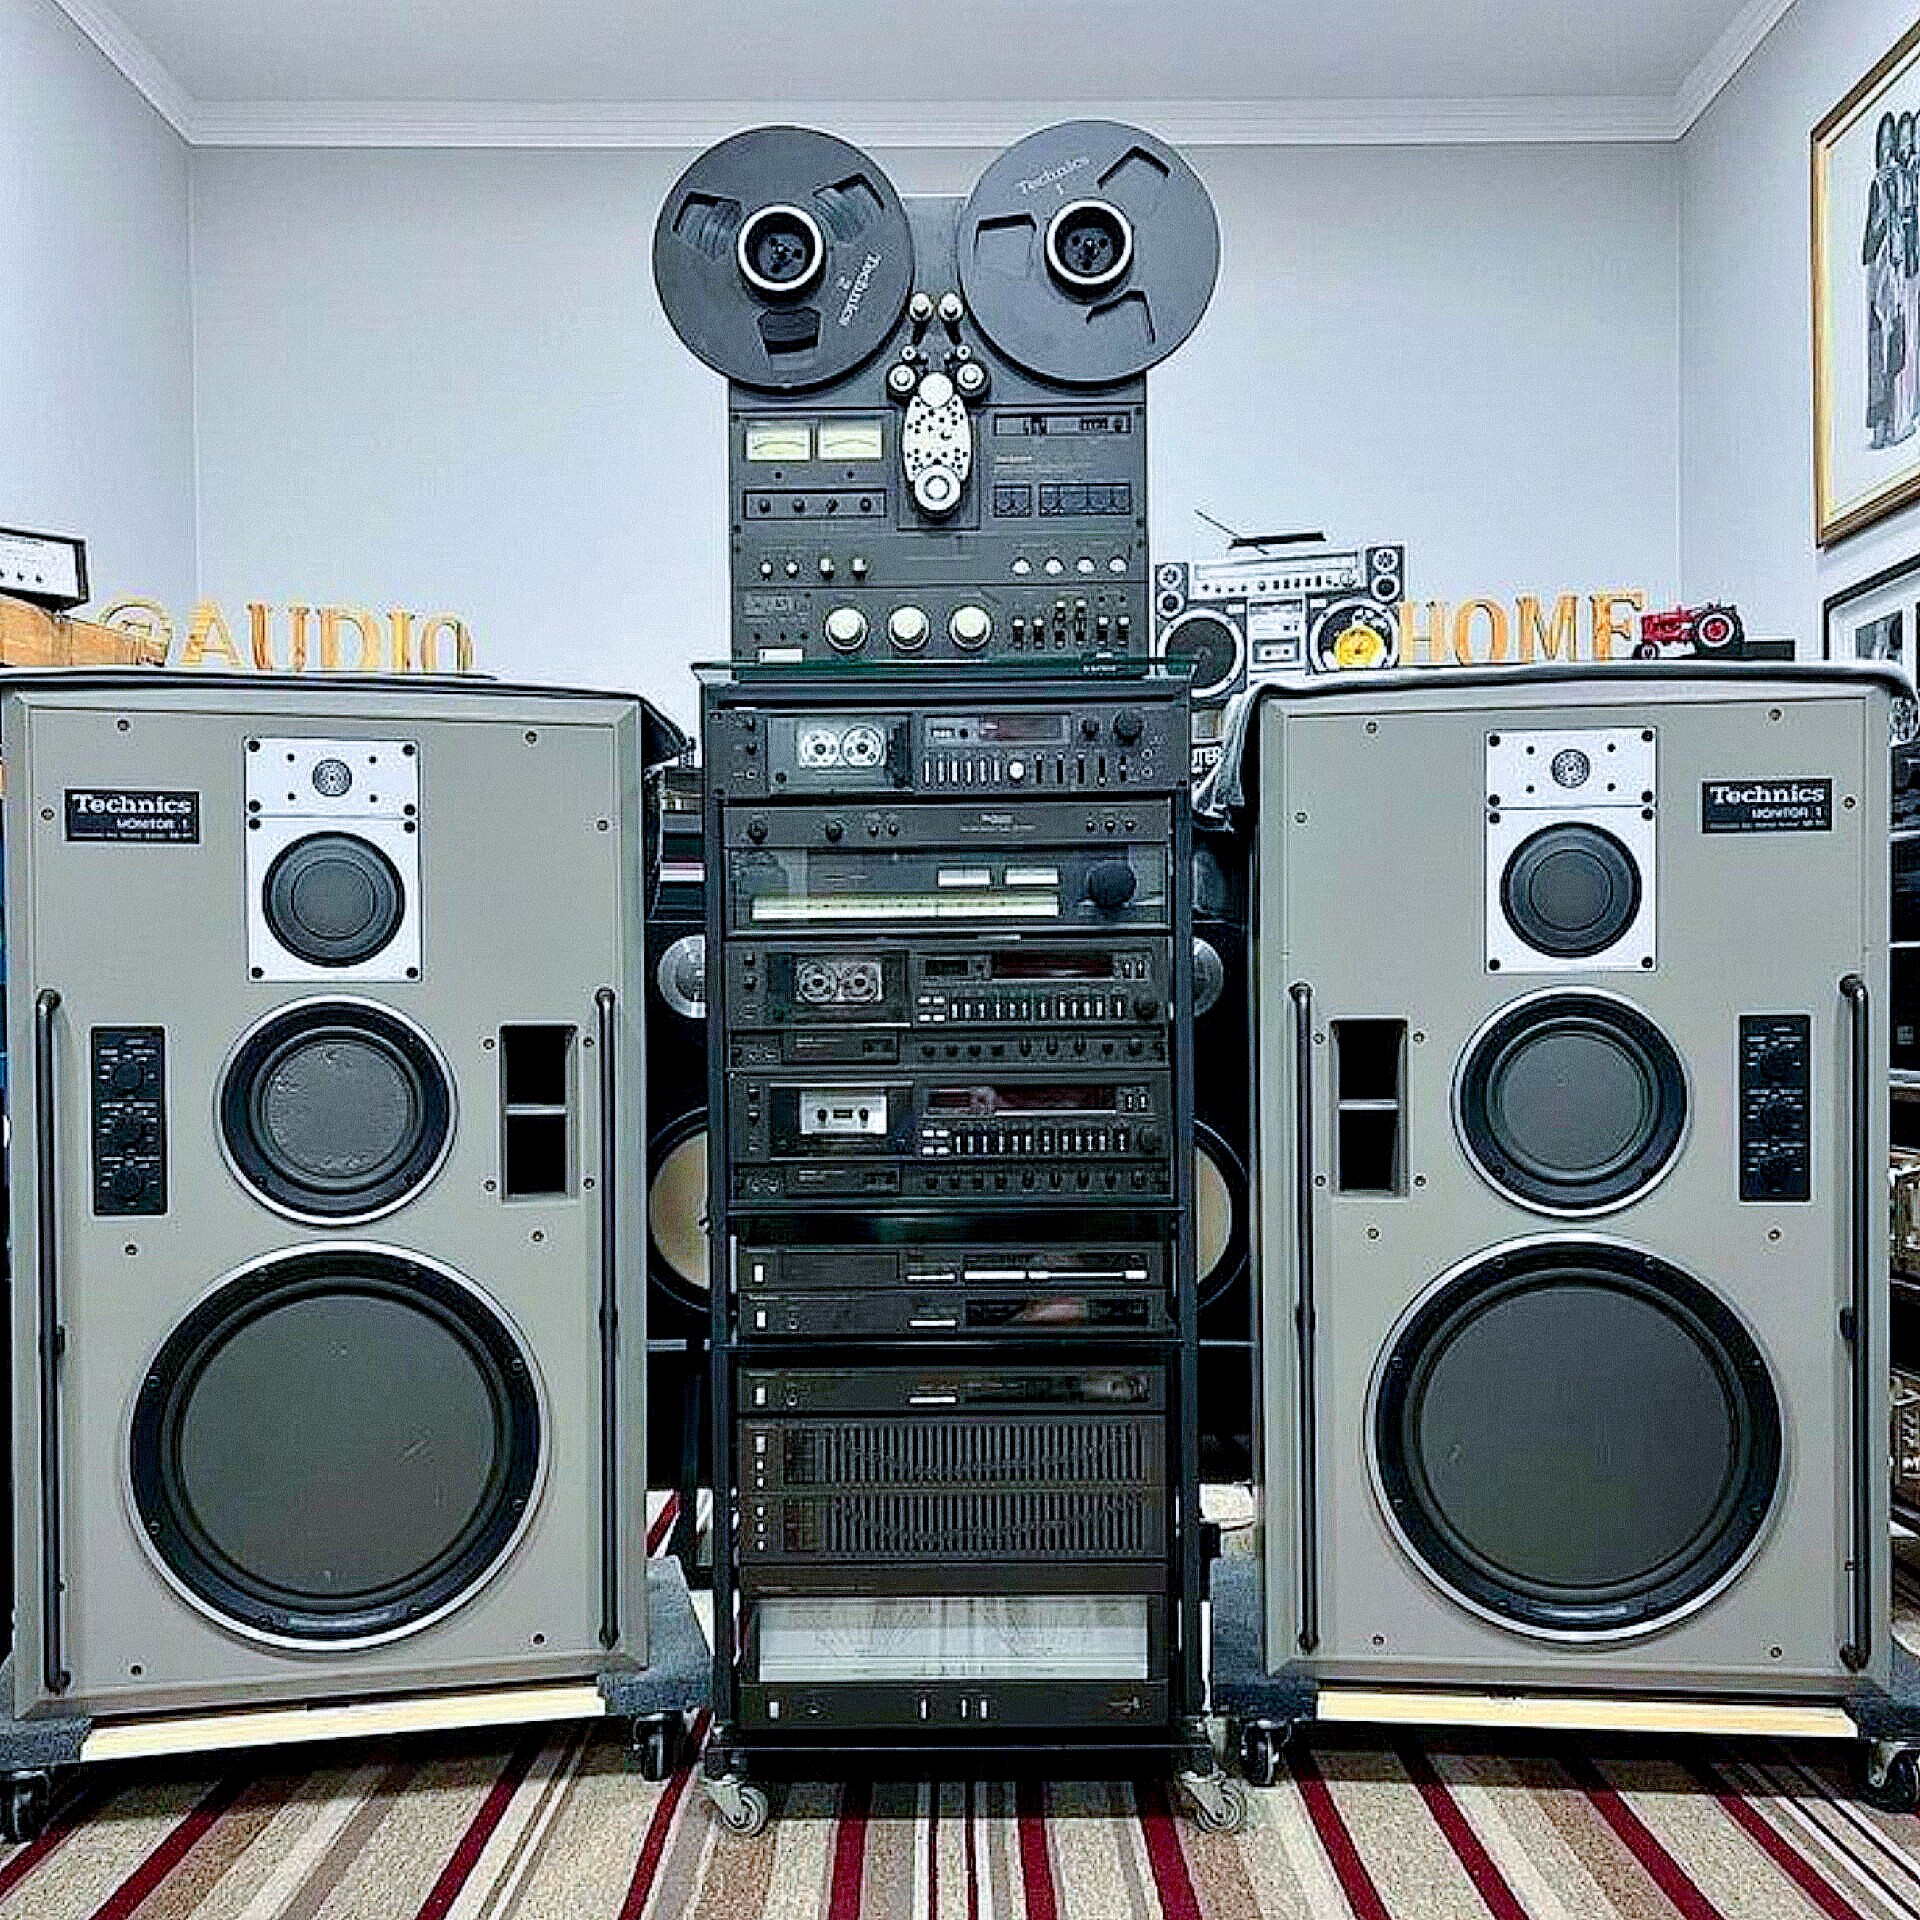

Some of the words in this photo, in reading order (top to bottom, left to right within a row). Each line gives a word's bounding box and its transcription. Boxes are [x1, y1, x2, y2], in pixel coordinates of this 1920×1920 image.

[1399, 588, 1645, 665] HOME
[72, 793, 192, 814] Technics
[1709, 785, 1825, 805] Technics
